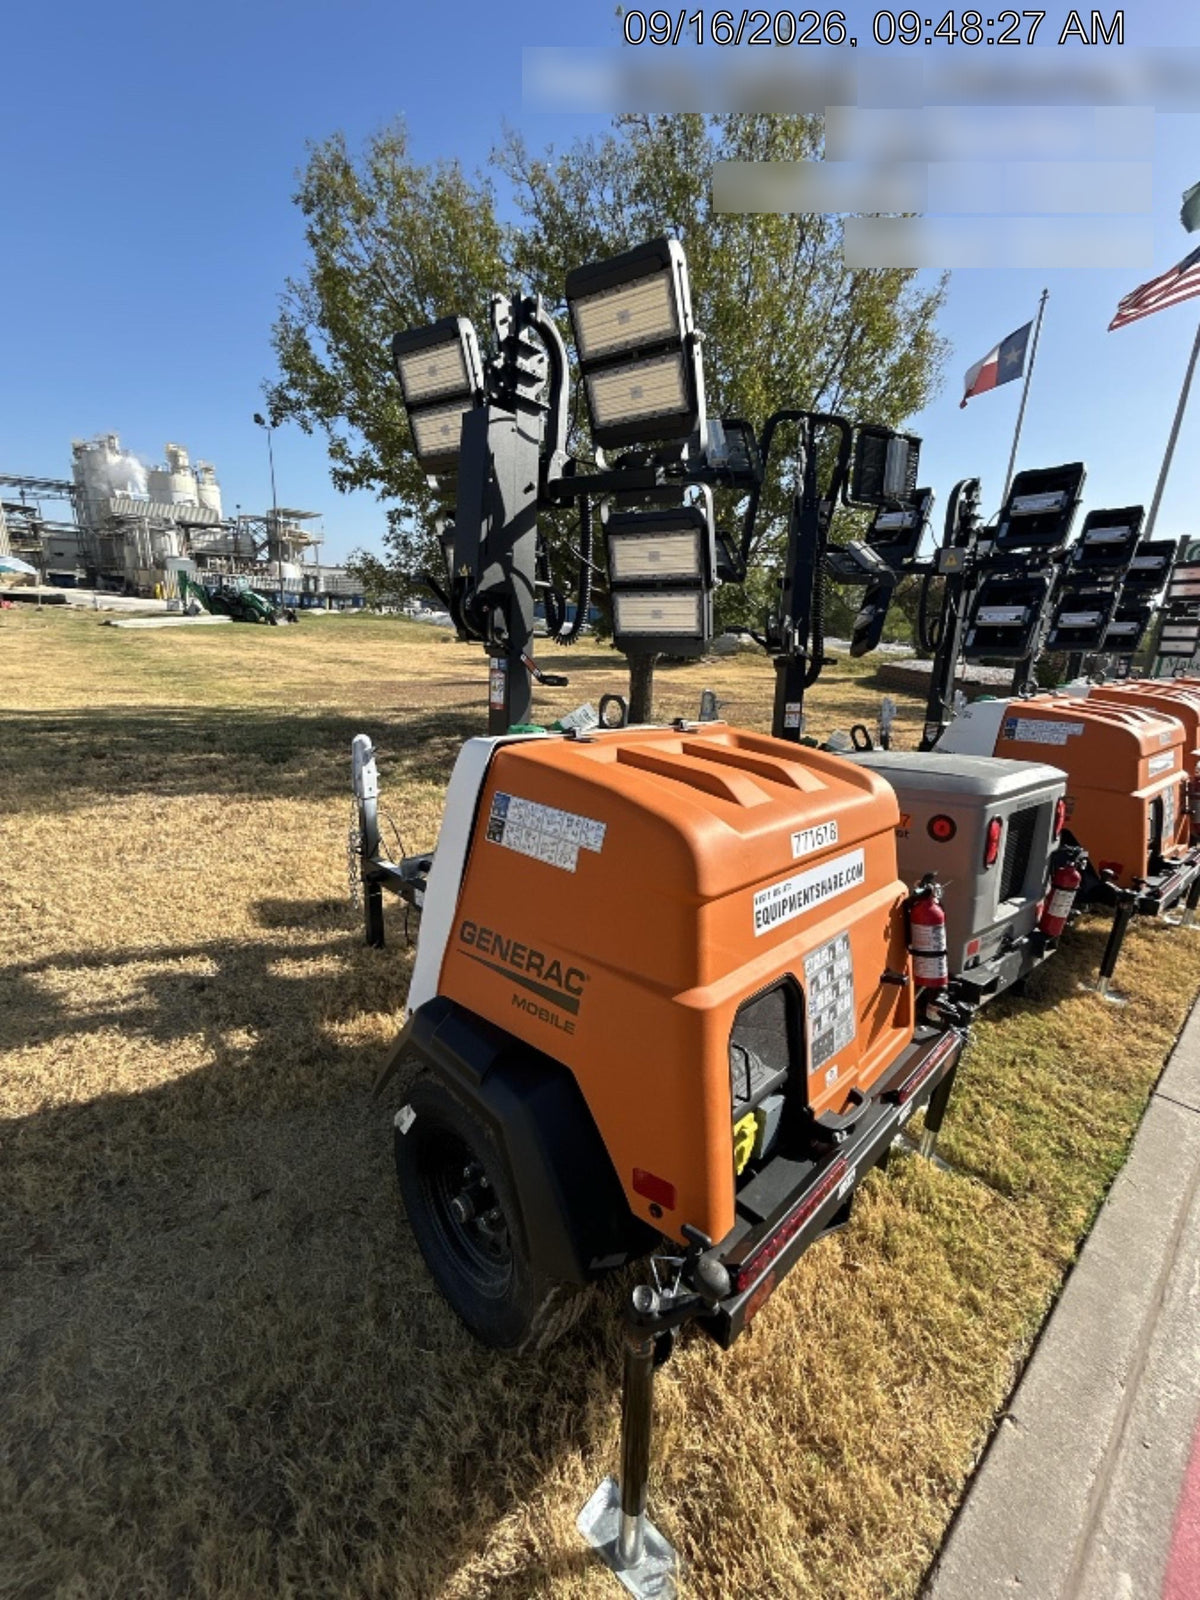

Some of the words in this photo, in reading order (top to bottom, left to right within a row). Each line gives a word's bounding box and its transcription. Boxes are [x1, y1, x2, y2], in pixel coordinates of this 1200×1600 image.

[755, 861, 863, 928] EQUIPMENTSHARE.COM
[459, 920, 586, 996] GENERAC
[511, 993, 576, 1036] MOBILE
